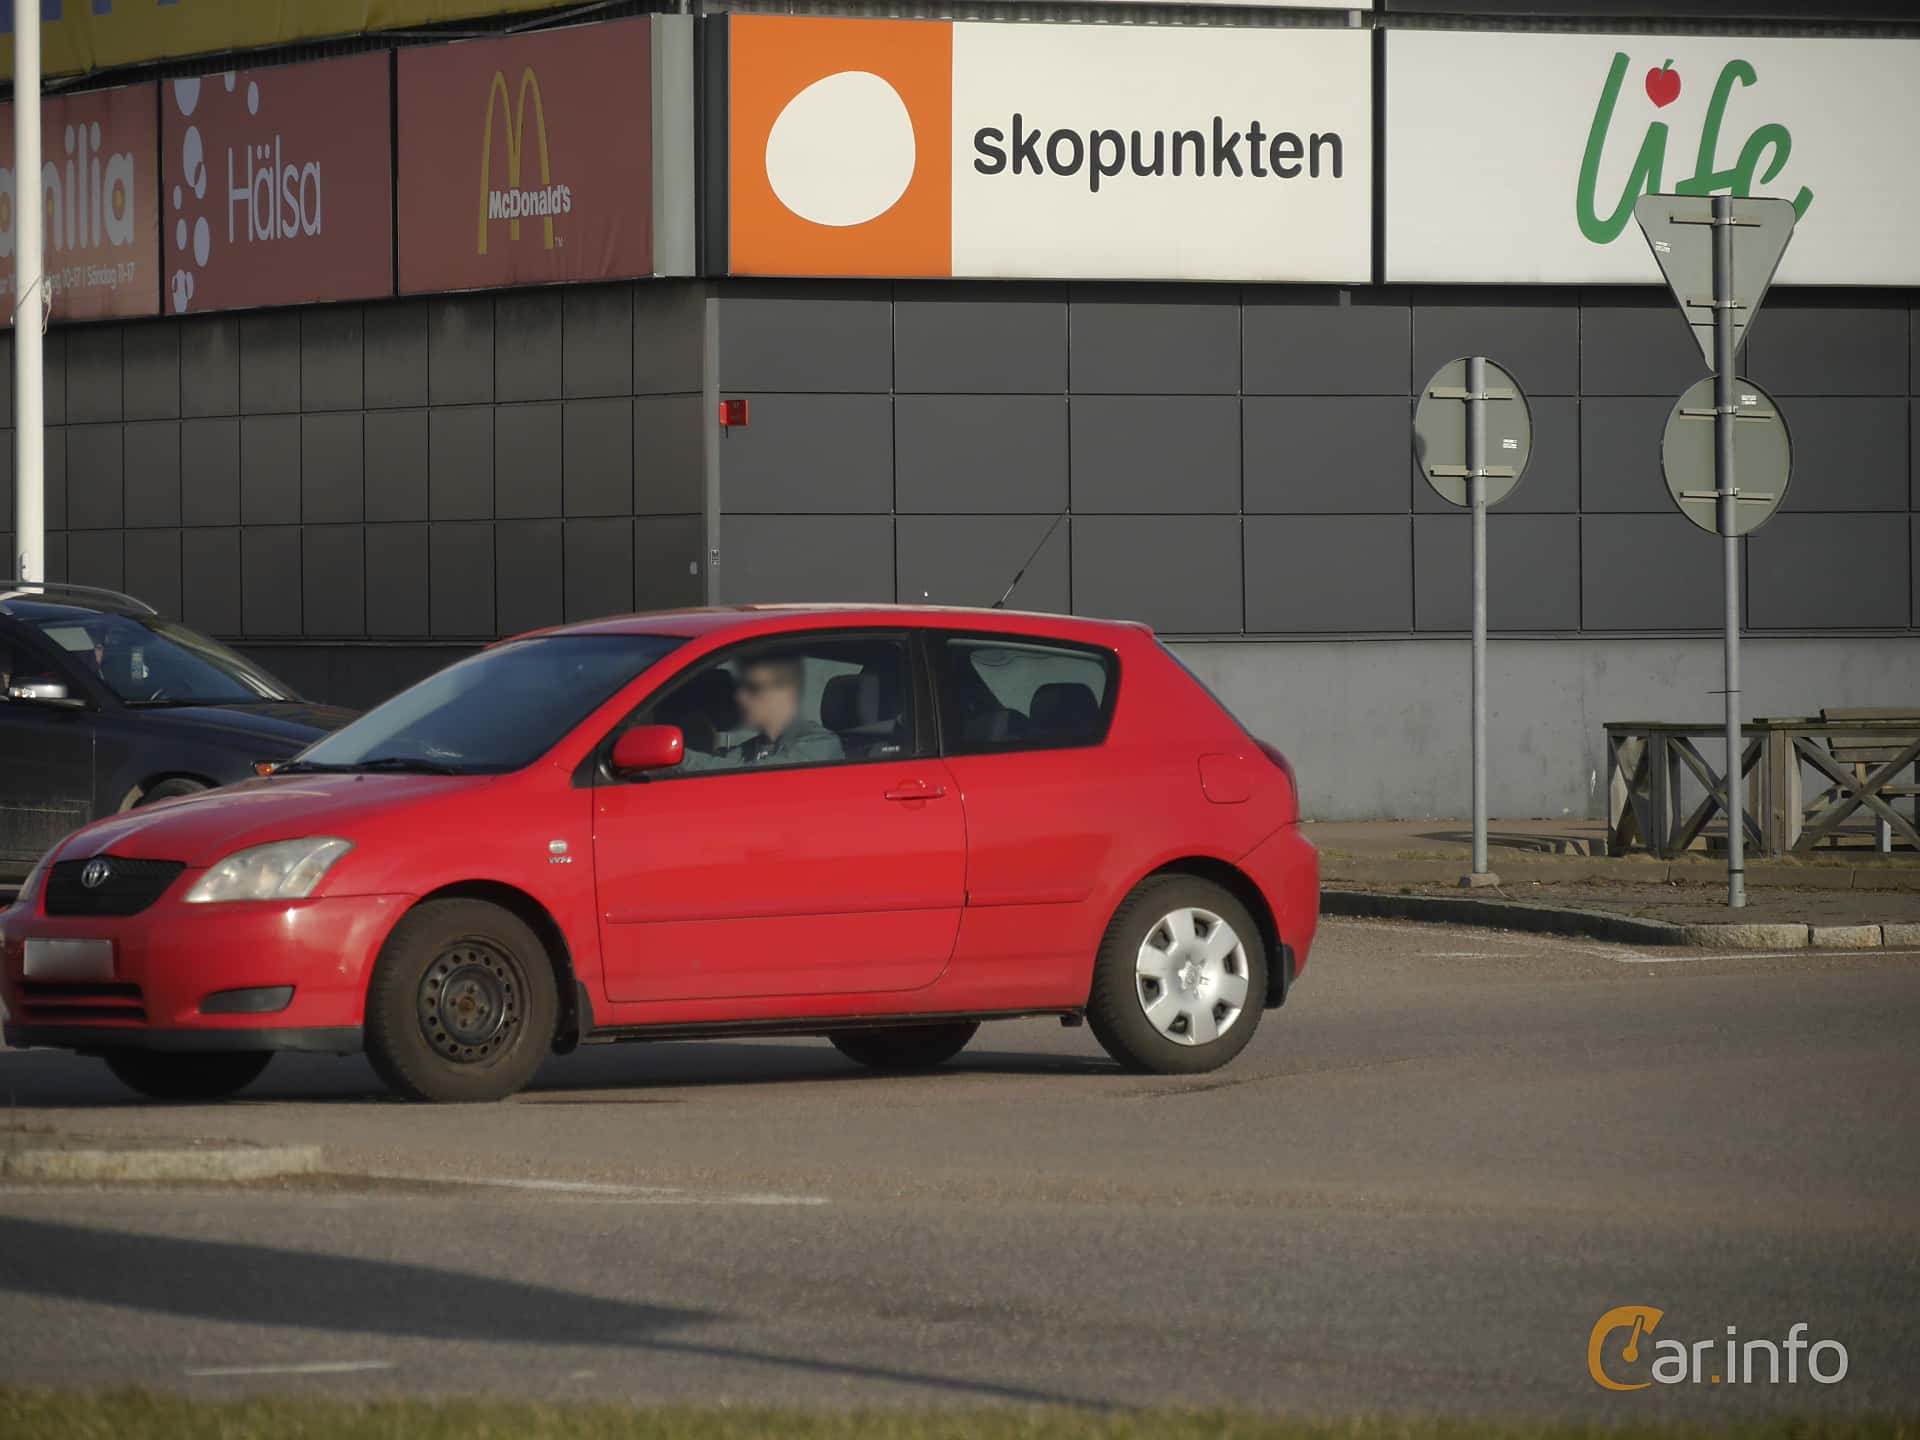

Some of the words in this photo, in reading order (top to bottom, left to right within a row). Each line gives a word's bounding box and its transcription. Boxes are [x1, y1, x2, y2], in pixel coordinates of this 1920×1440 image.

[228, 134, 321, 243] Hälsa
[973, 112, 1343, 193] skopunkten
[488, 184, 571, 219] McDonald's
